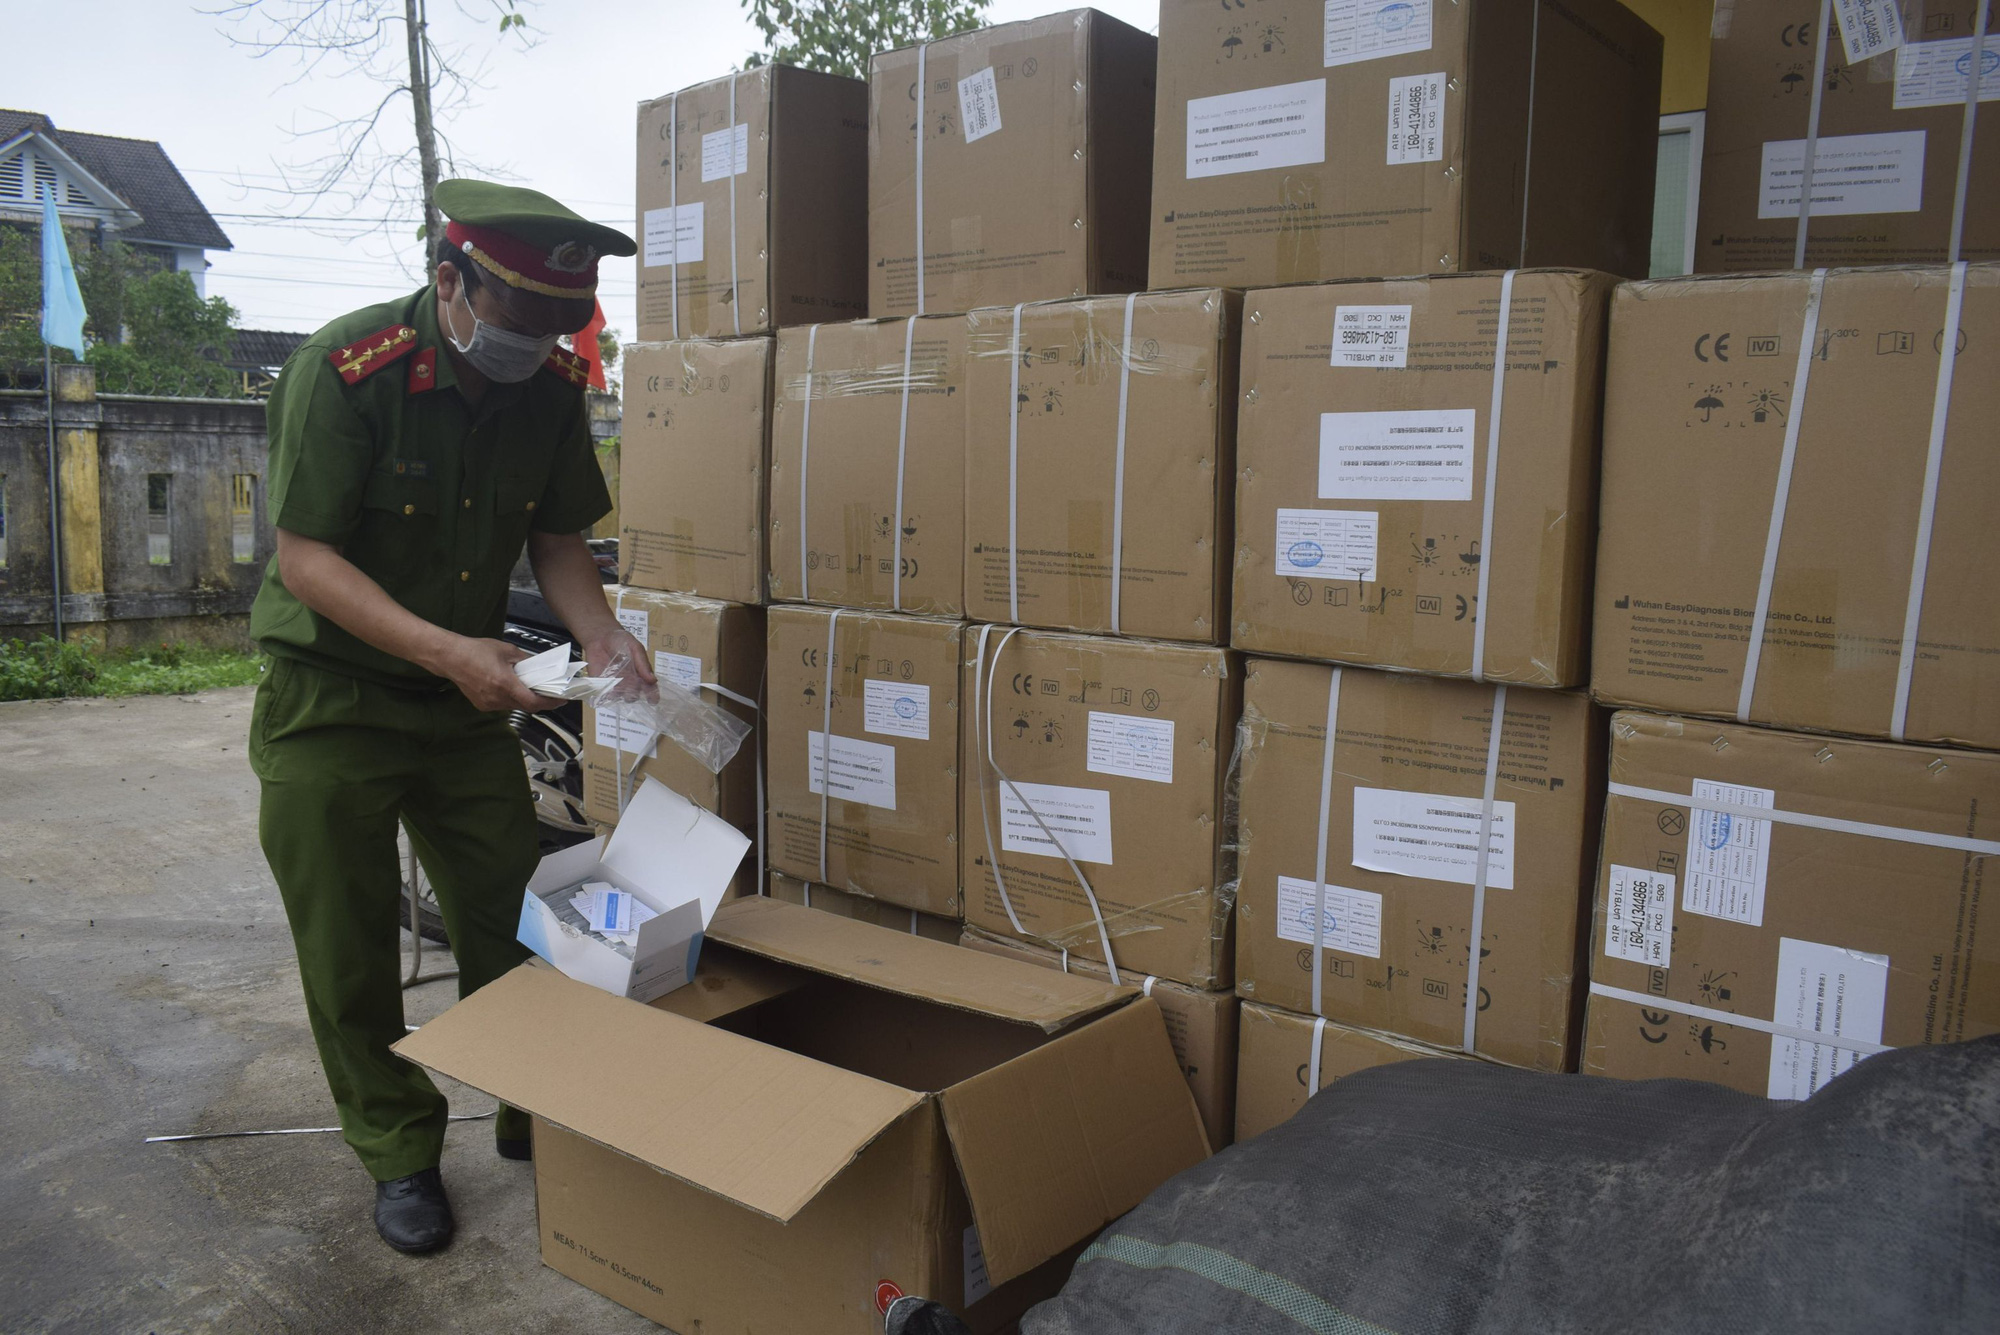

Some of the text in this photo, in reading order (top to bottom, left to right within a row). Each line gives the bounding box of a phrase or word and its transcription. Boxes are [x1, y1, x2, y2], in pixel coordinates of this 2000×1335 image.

[1846, 15, 1854, 30] CKG
[1781, 23, 1810, 47] CE
[1393, 91, 1401, 129] WAYBILL
[1408, 85, 1422, 151] 160-41344866
[1176, 212, 1198, 220] Wuhan
[1390, 314, 1405, 322] HAN
[1342, 331, 1398, 344] 160-41344866
[1752, 340, 1776, 352] IVD
[1343, 353, 1394, 362] AIR WAYBILL
[1694, 333, 1730, 363] CE
[1513, 362, 1540, 371] Wuhan
[1419, 600, 1438, 611] IVD
[1632, 600, 1835, 625] Wuhan EasyDiagnosis Biomicine Co., Ltd.
[802, 648, 817, 668] CE
[1012, 673, 1033, 696] CE
[1043, 682, 1057, 693] IVD
[1379, 755, 1394, 764] Ltd.
[1412, 759, 1458, 773] Biomedicine
[1519, 775, 1547, 786] Wuhan
[1613, 879, 1623, 920] WAYBILL
[1629, 880, 1648, 949] 160-41344866
[1652, 883, 1665, 960] HAN CKG 500
[1426, 983, 1445, 996] IVD
[1652, 970, 1664, 992] IVD
[1922, 953, 1943, 1045] iomedicine Co., Ltd.
[1639, 1008, 1670, 1044] CE
[553, 1231, 578, 1251] MEAS:
